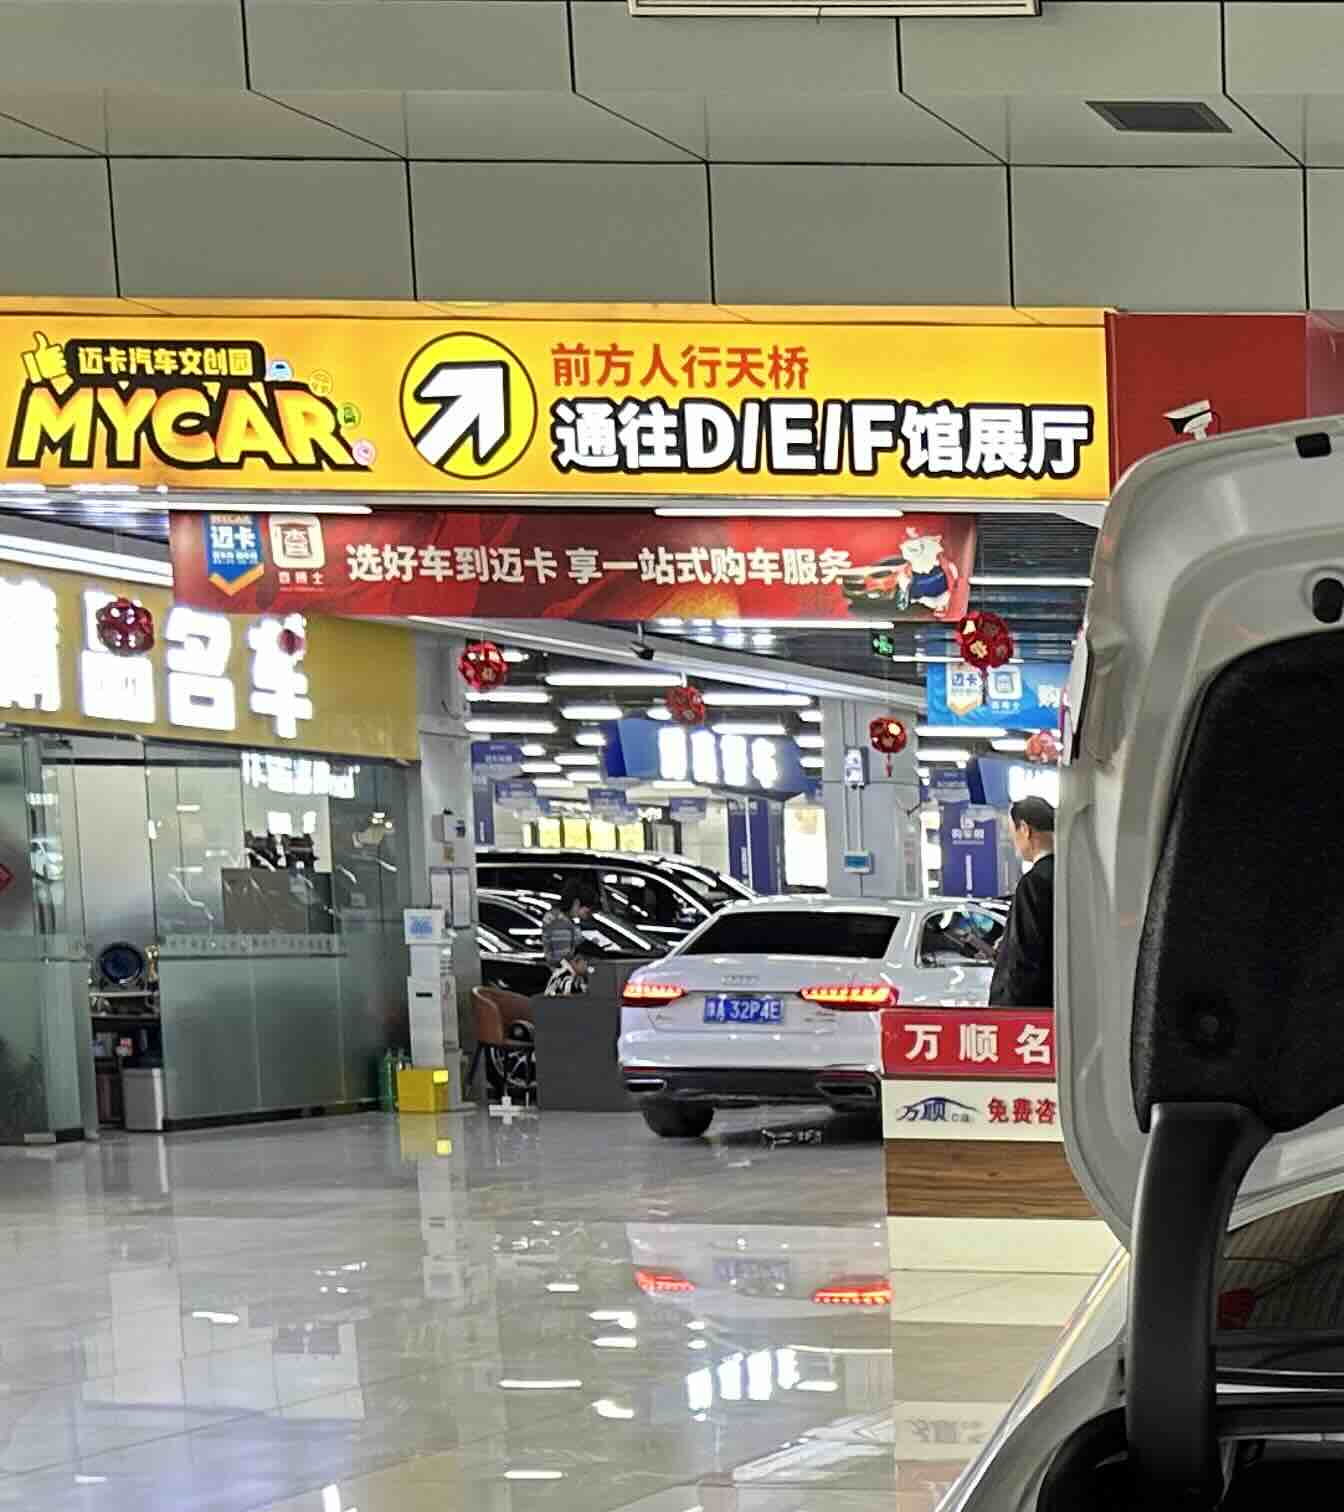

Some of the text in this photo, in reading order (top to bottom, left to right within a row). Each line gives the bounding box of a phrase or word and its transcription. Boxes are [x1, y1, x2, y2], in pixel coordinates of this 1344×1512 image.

[77, 346, 254, 378] 迈卡汽车文创园
[551, 342, 810, 391] 前方人行天桥
[15, 384, 356, 468] MYCAR
[554, 399, 1090, 476] 通往D/E/F馆展厅
[210, 525, 257, 550] 迈卡
[346, 543, 853, 586] 选好车到迈卡 享一站式购车服务
[903, 1023, 1051, 1065] 万顺名
